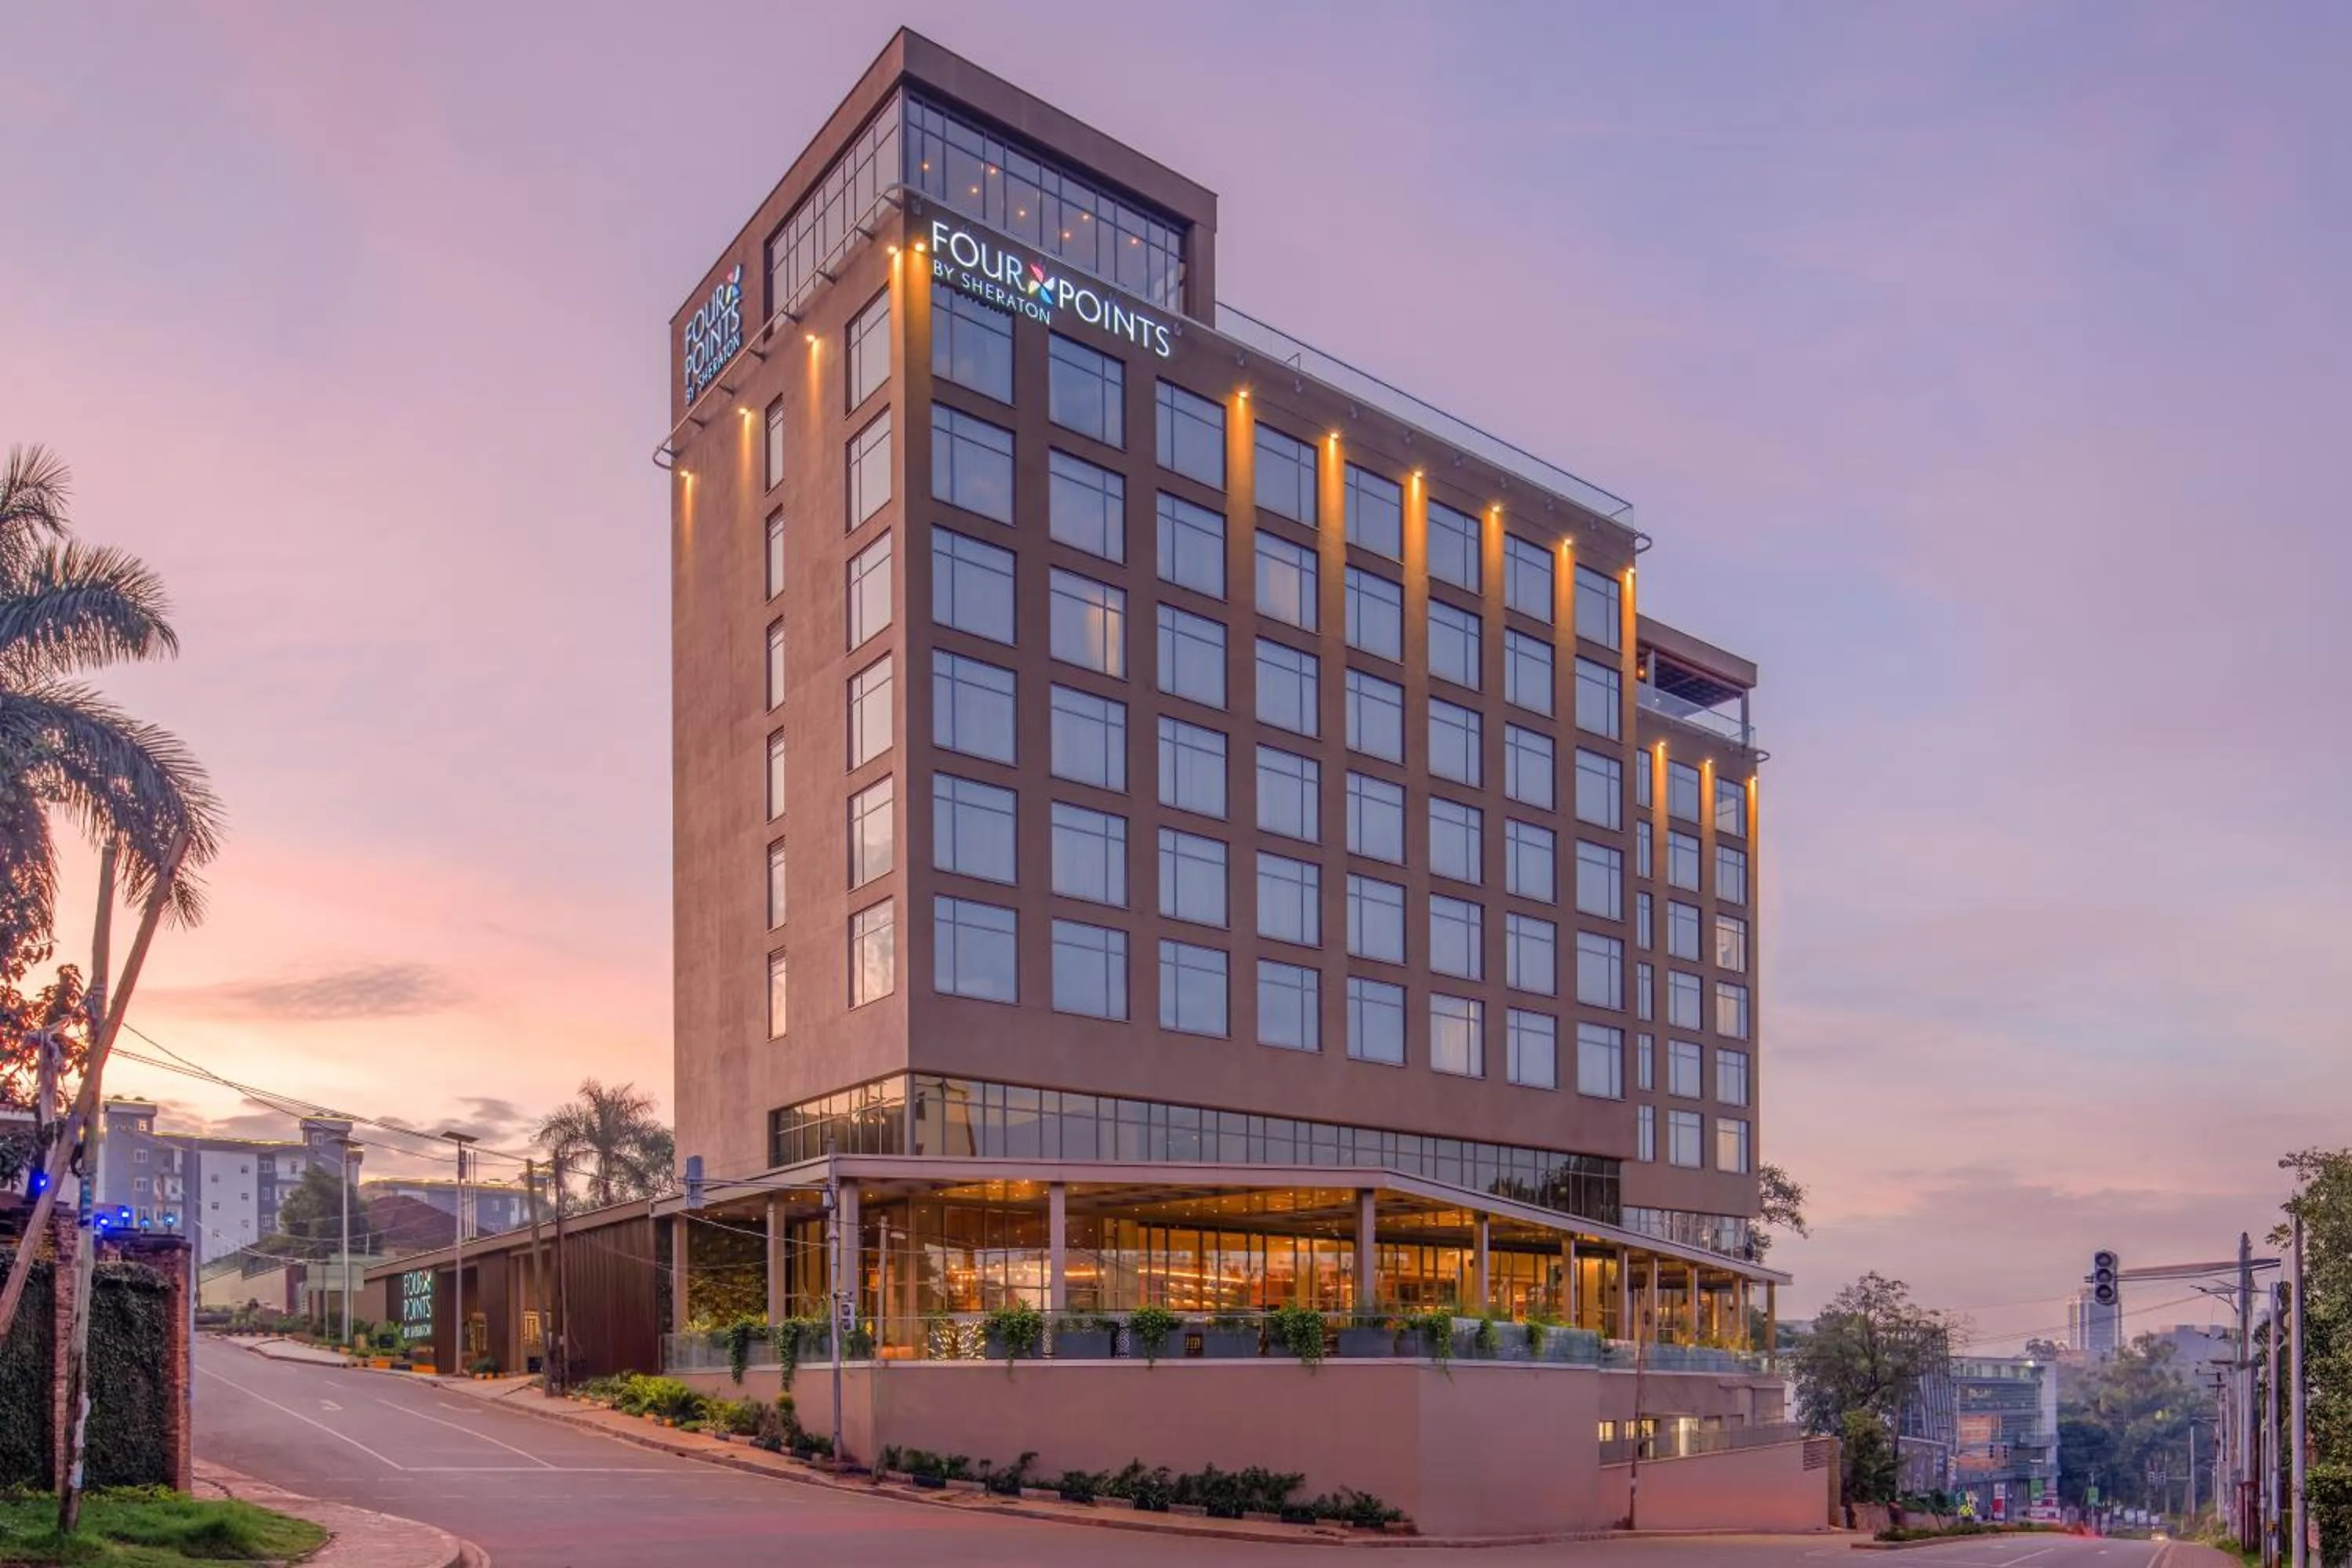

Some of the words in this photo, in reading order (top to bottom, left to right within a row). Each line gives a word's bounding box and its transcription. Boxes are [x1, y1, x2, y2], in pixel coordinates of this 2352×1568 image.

[685, 284, 726, 353] FOUR
[932, 220, 1025, 291] FOUR
[1059, 279, 1170, 358] POINTS
[933, 260, 954, 281] BY
[962, 274, 1050, 326] SHERATON
[685, 299, 740, 387] POINTS
[685, 384, 695, 405] BY
[699, 332, 741, 390] SHERATON
[404, 1294, 431, 1321] POINTS
